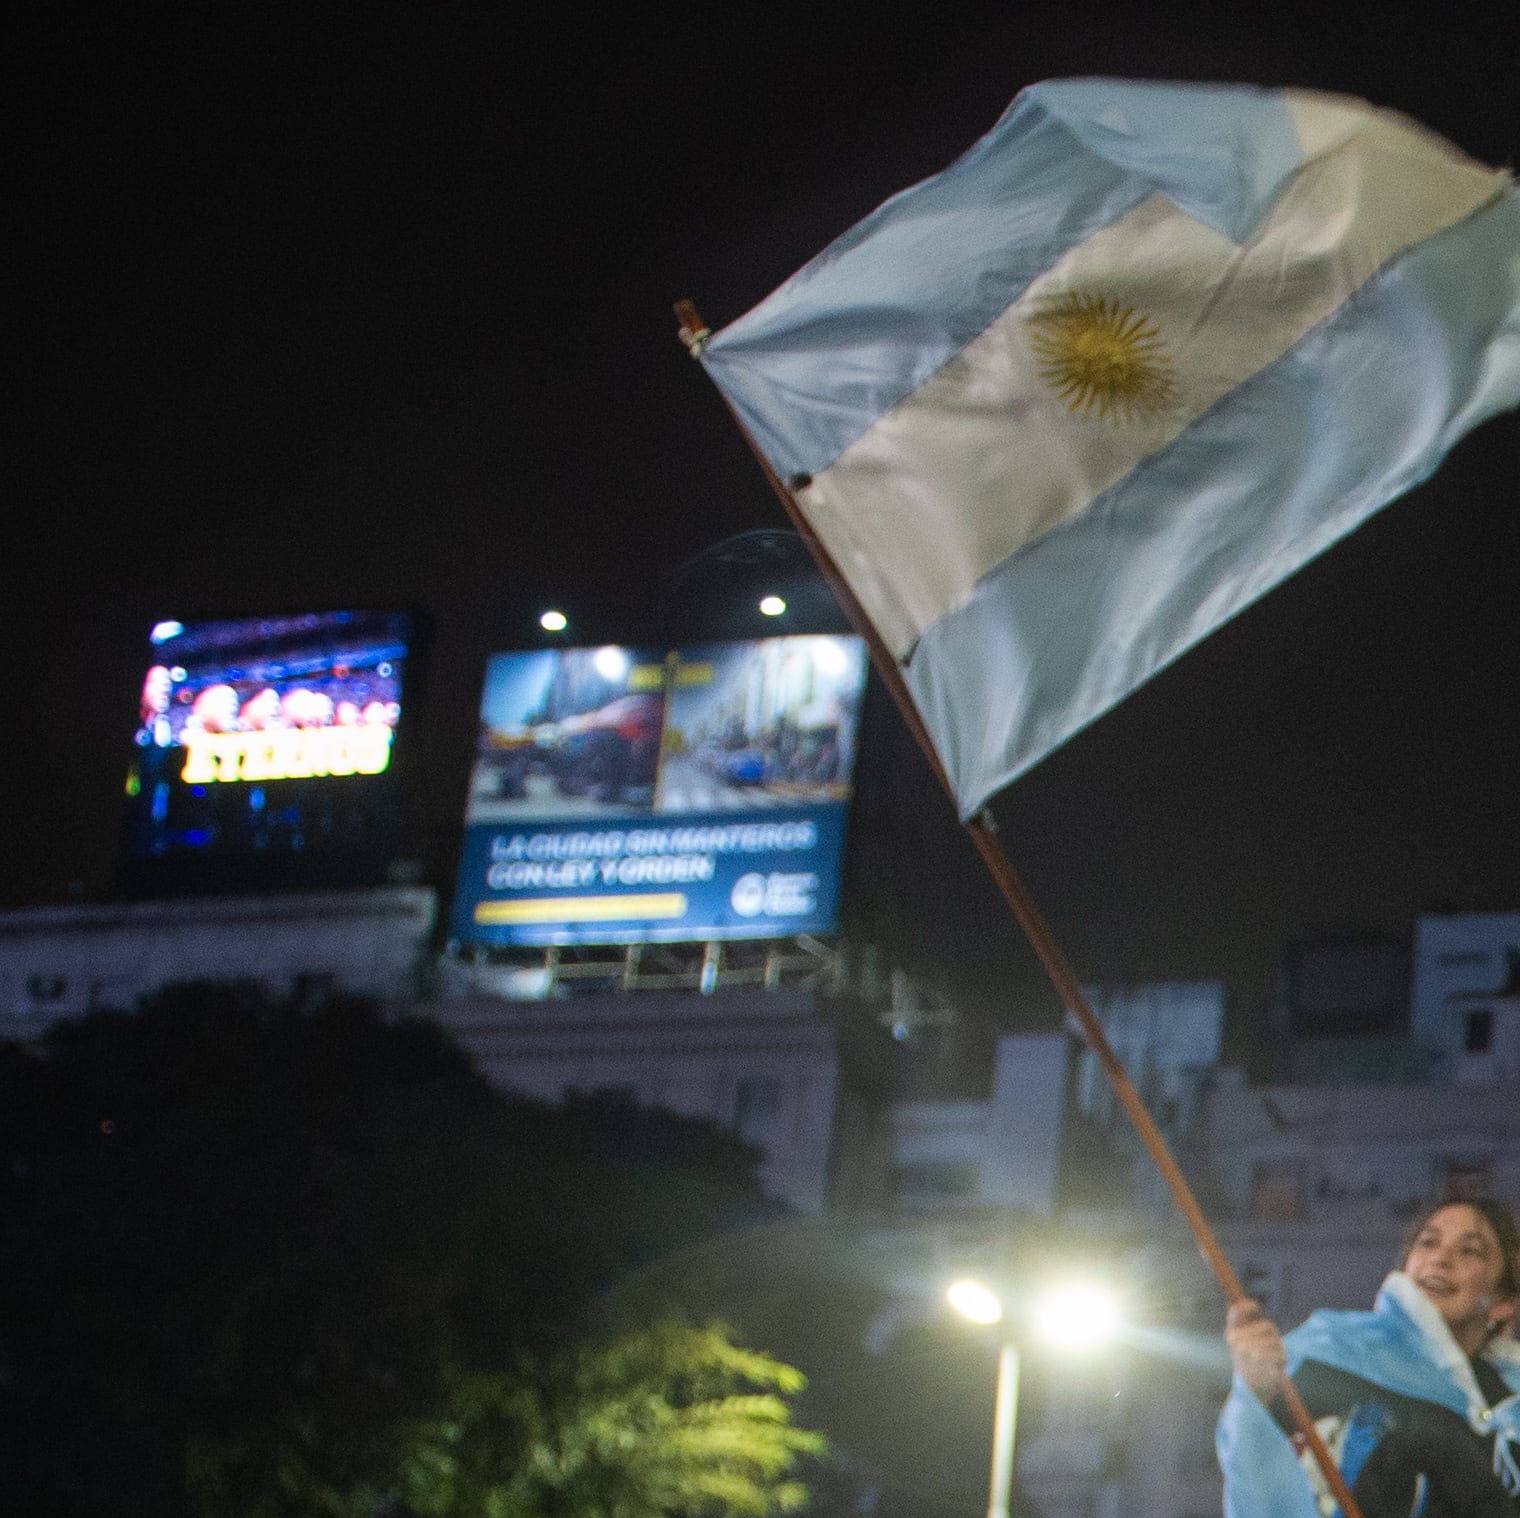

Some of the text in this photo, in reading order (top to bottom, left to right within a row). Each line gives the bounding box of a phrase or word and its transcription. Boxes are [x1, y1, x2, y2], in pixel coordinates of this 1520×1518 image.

[491, 820, 818, 860] LA CIUDAD SIN MANTEROS
[486, 853, 715, 889] CON LEY Y ORDEN
